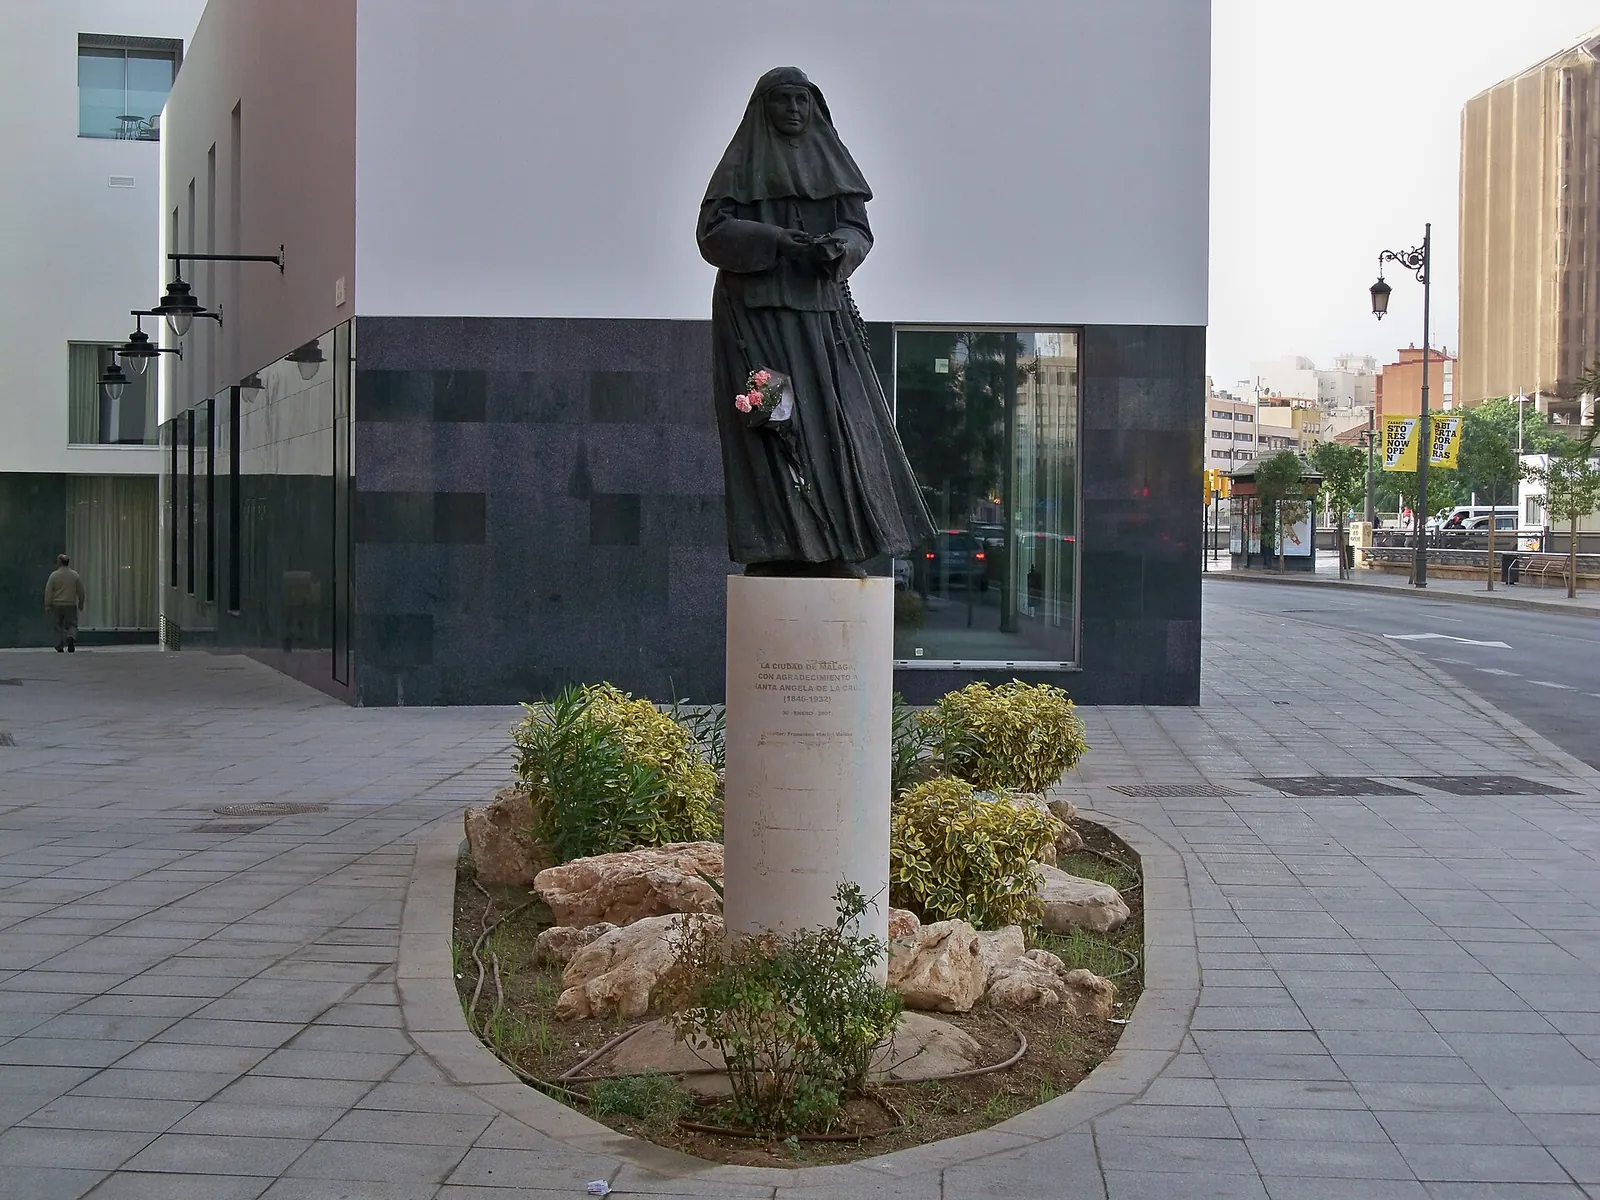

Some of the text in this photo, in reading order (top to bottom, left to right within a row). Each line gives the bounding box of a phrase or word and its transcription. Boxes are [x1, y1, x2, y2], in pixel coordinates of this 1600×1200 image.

[1387, 425, 1407, 433] STO
[1434, 429, 1457, 437] ERTA
[1432, 450, 1451, 459] RAS
[783, 695, 831, 704] (1846-1932)
